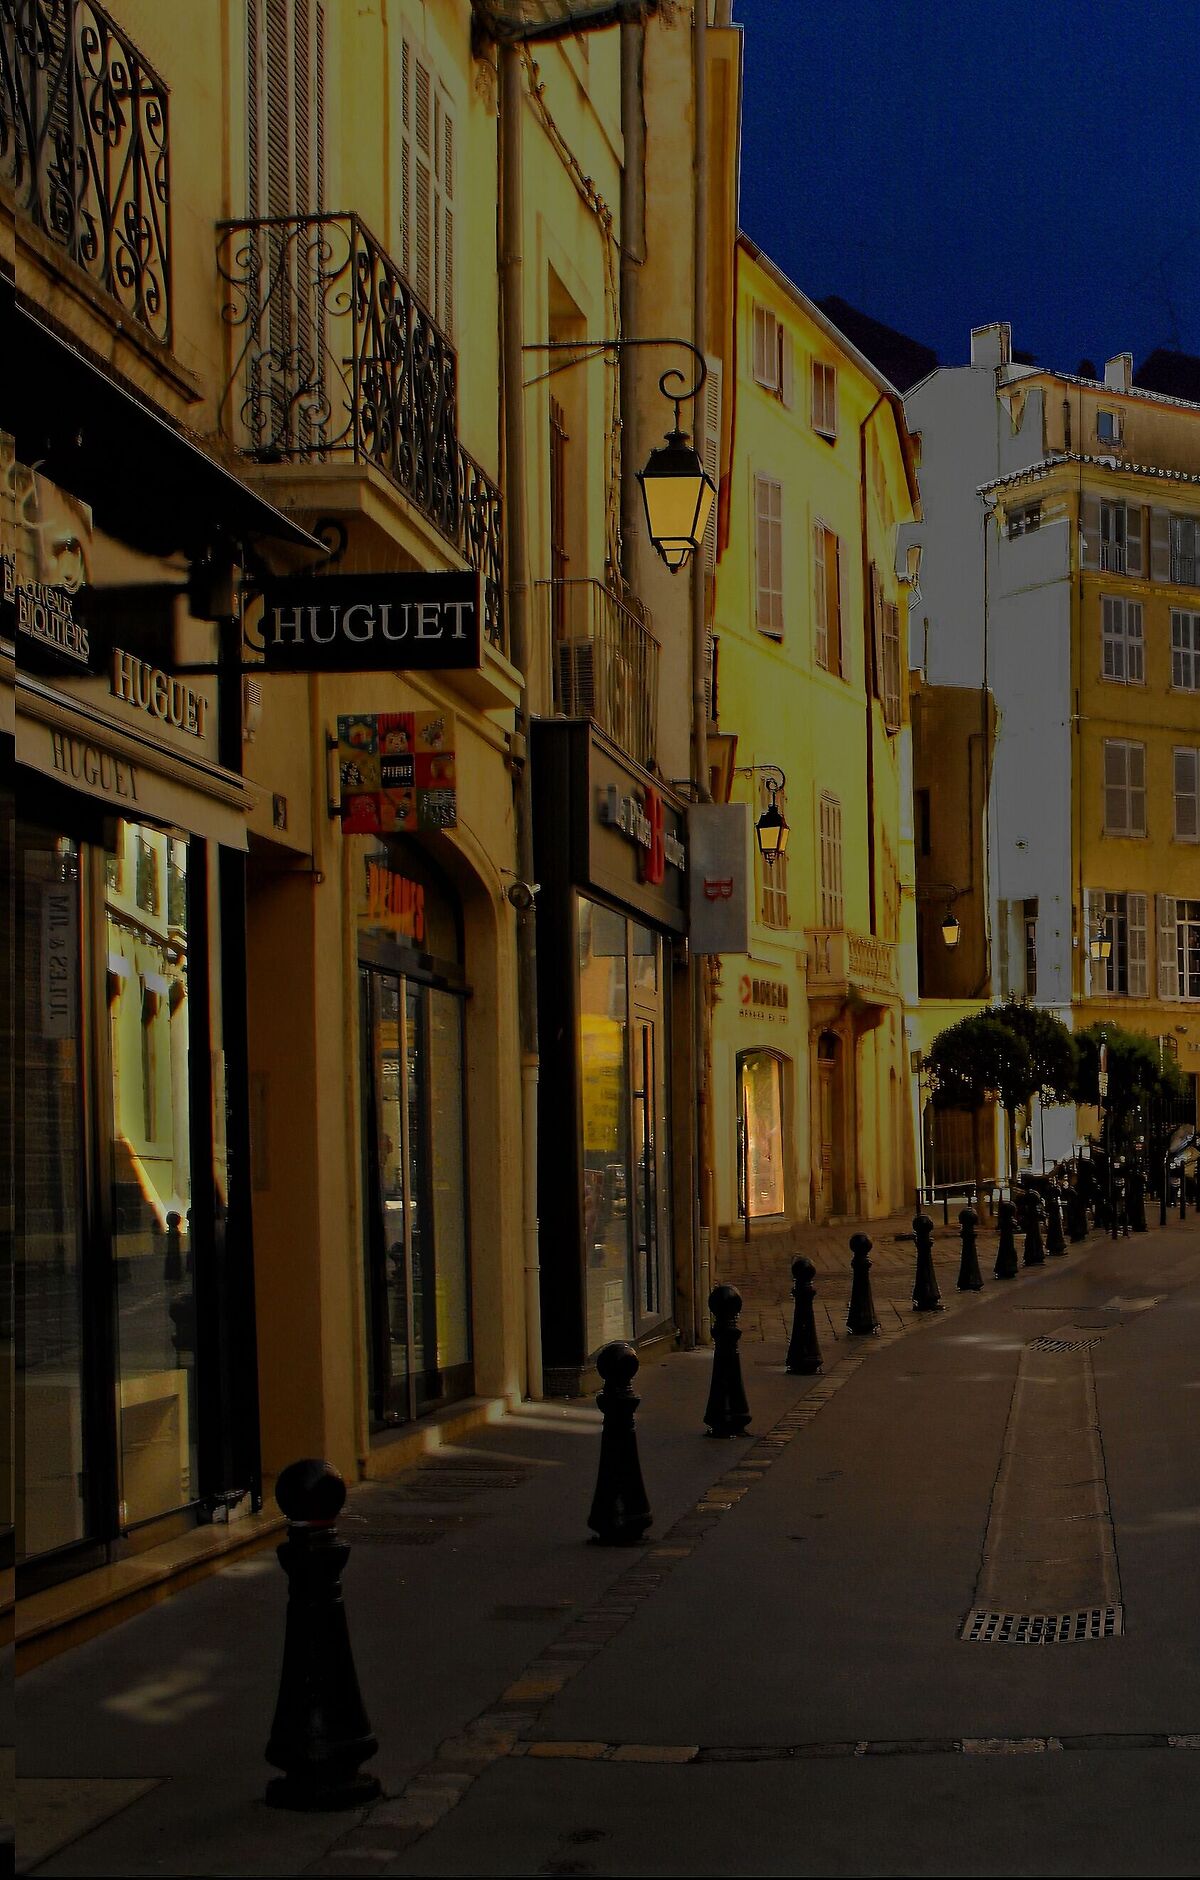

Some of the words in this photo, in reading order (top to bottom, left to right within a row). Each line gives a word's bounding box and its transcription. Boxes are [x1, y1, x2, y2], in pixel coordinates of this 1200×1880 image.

[271, 601, 474, 644] HUGUET
[109, 646, 208, 740] HUGUET
[52, 730, 140, 801] HUGUET
